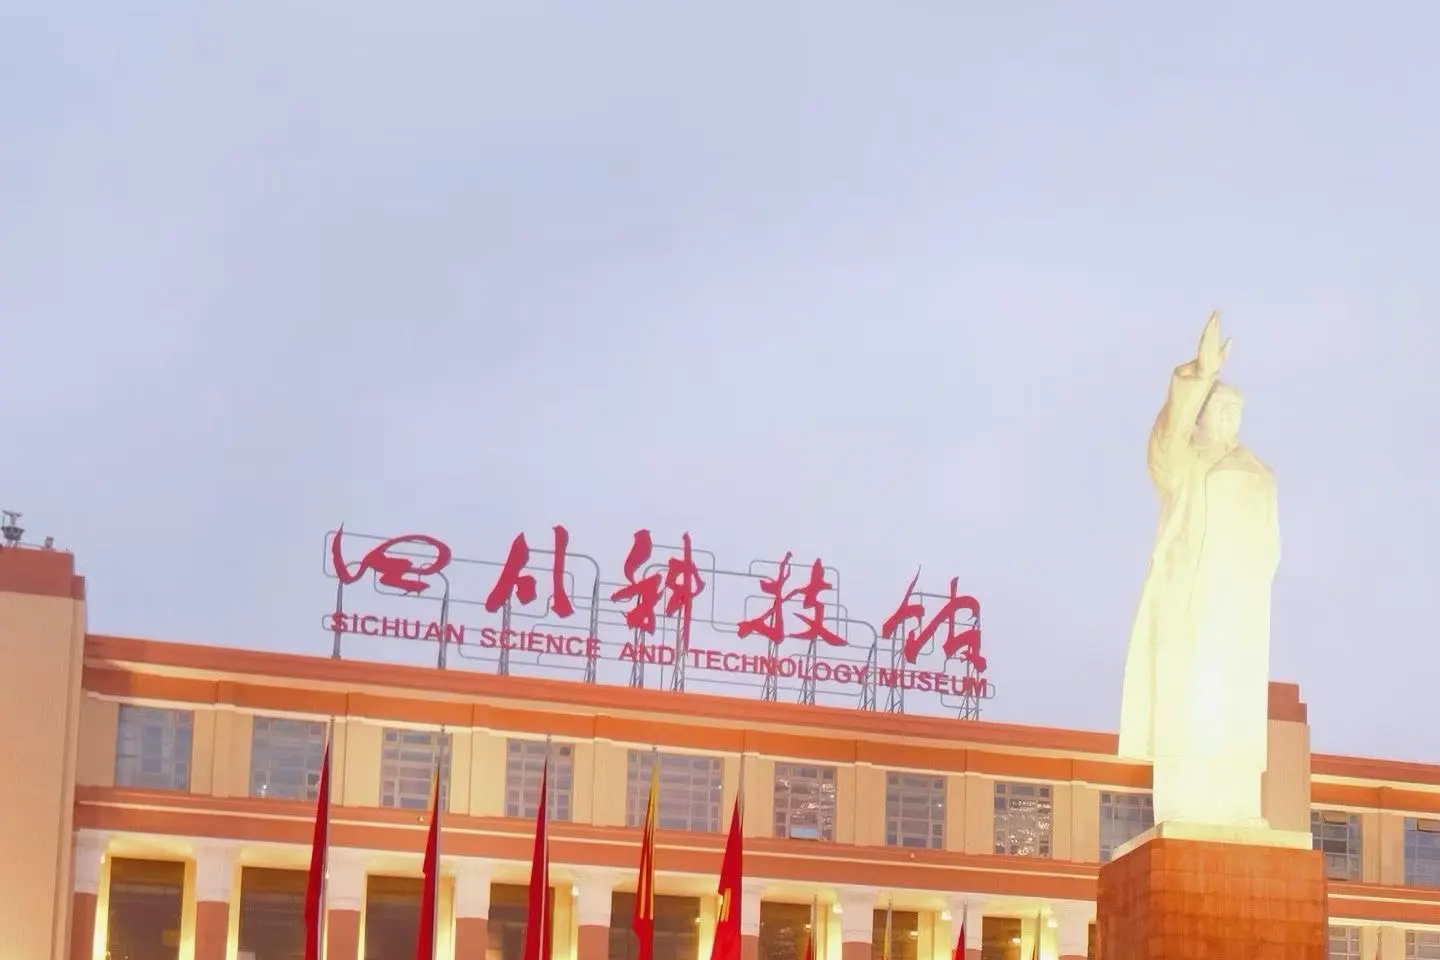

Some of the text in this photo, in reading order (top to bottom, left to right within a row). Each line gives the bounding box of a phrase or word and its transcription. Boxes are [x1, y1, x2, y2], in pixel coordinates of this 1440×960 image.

[330, 610, 988, 698] SICHUAN SCIENCE AND TECHNOLOGY MUSEUM
[331, 521, 988, 673] 四川科技馆
